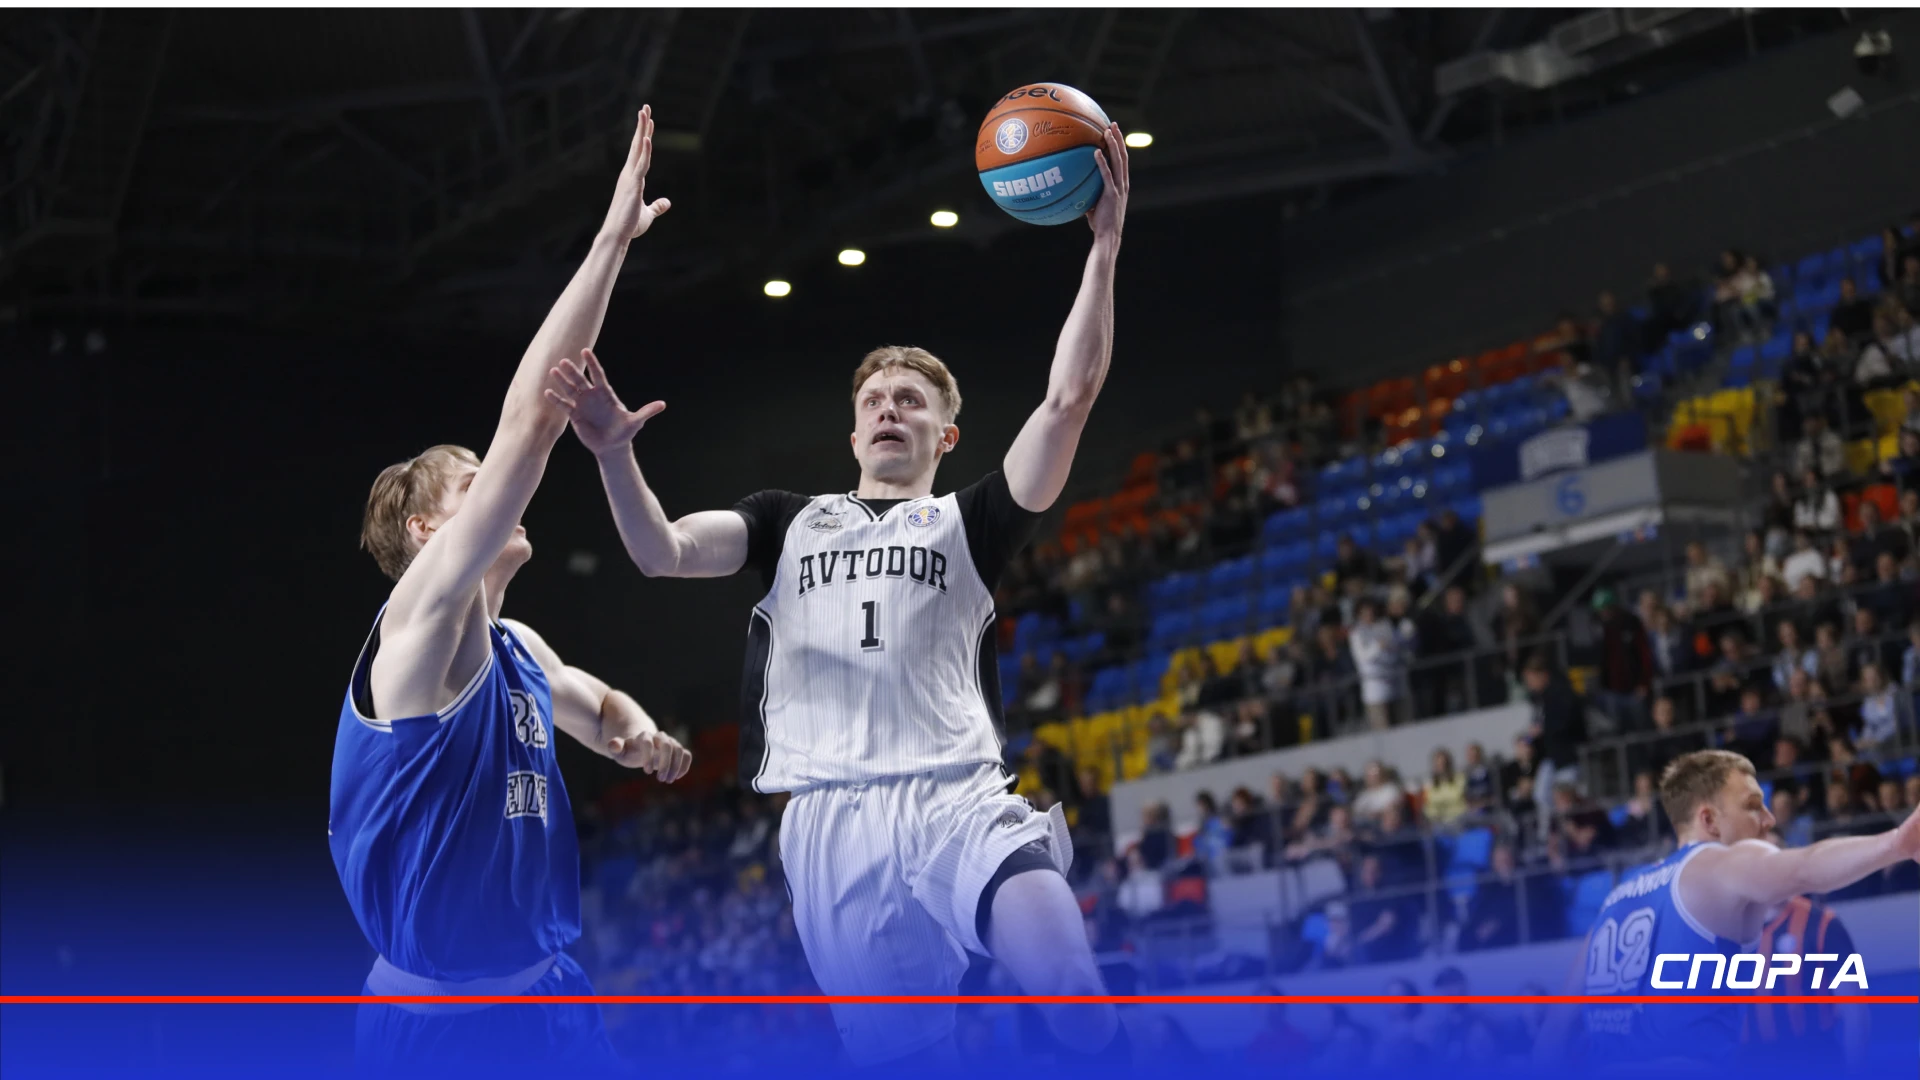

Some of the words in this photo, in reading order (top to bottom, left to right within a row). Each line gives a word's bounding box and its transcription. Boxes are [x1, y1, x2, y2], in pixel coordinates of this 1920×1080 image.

[992, 166, 1064, 197] SIBUR
[1556, 475, 1587, 517] 6
[799, 545, 948, 598] AVTODOR
[860, 600, 884, 652] 1
[1586, 907, 1656, 995] 12
